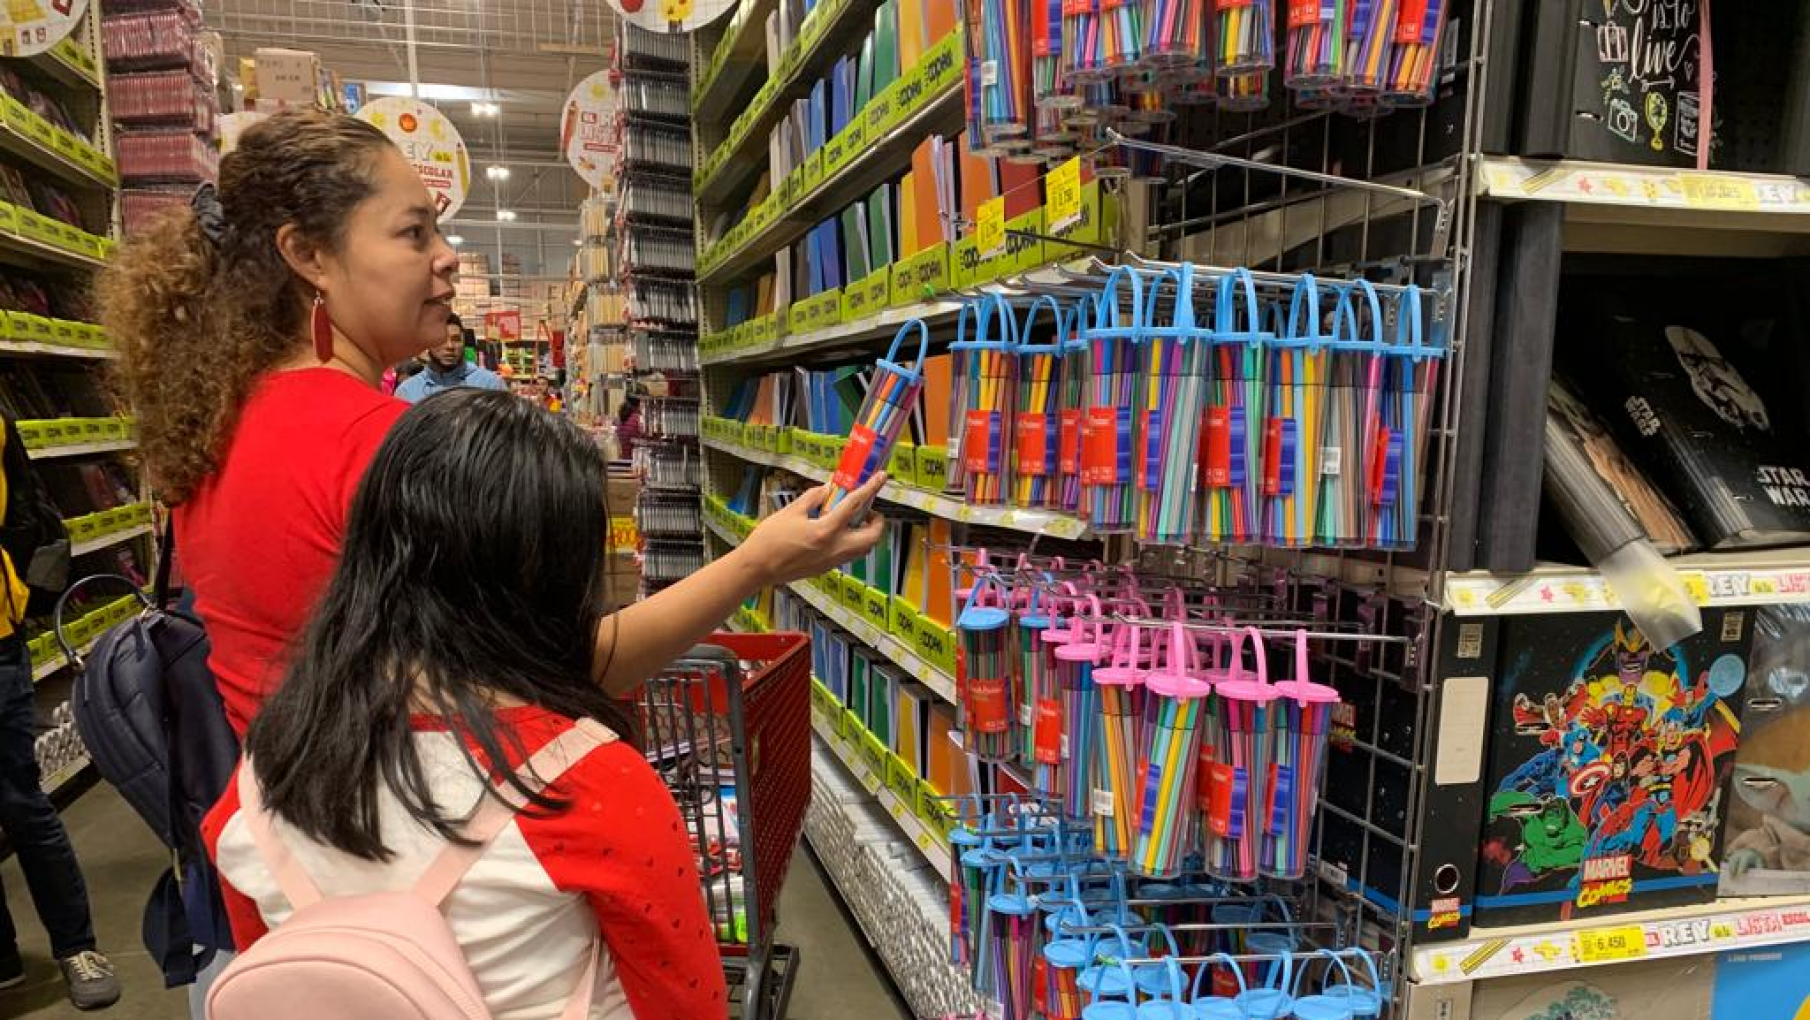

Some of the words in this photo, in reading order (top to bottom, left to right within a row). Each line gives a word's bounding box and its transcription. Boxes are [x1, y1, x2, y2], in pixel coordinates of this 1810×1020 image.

[1628, 16, 1701, 84] live
[1756, 465, 1810, 486] STAR
[1583, 855, 1631, 880] MARVEL
[1577, 877, 1632, 907] COMICS
[1661, 918, 1711, 948] REY
